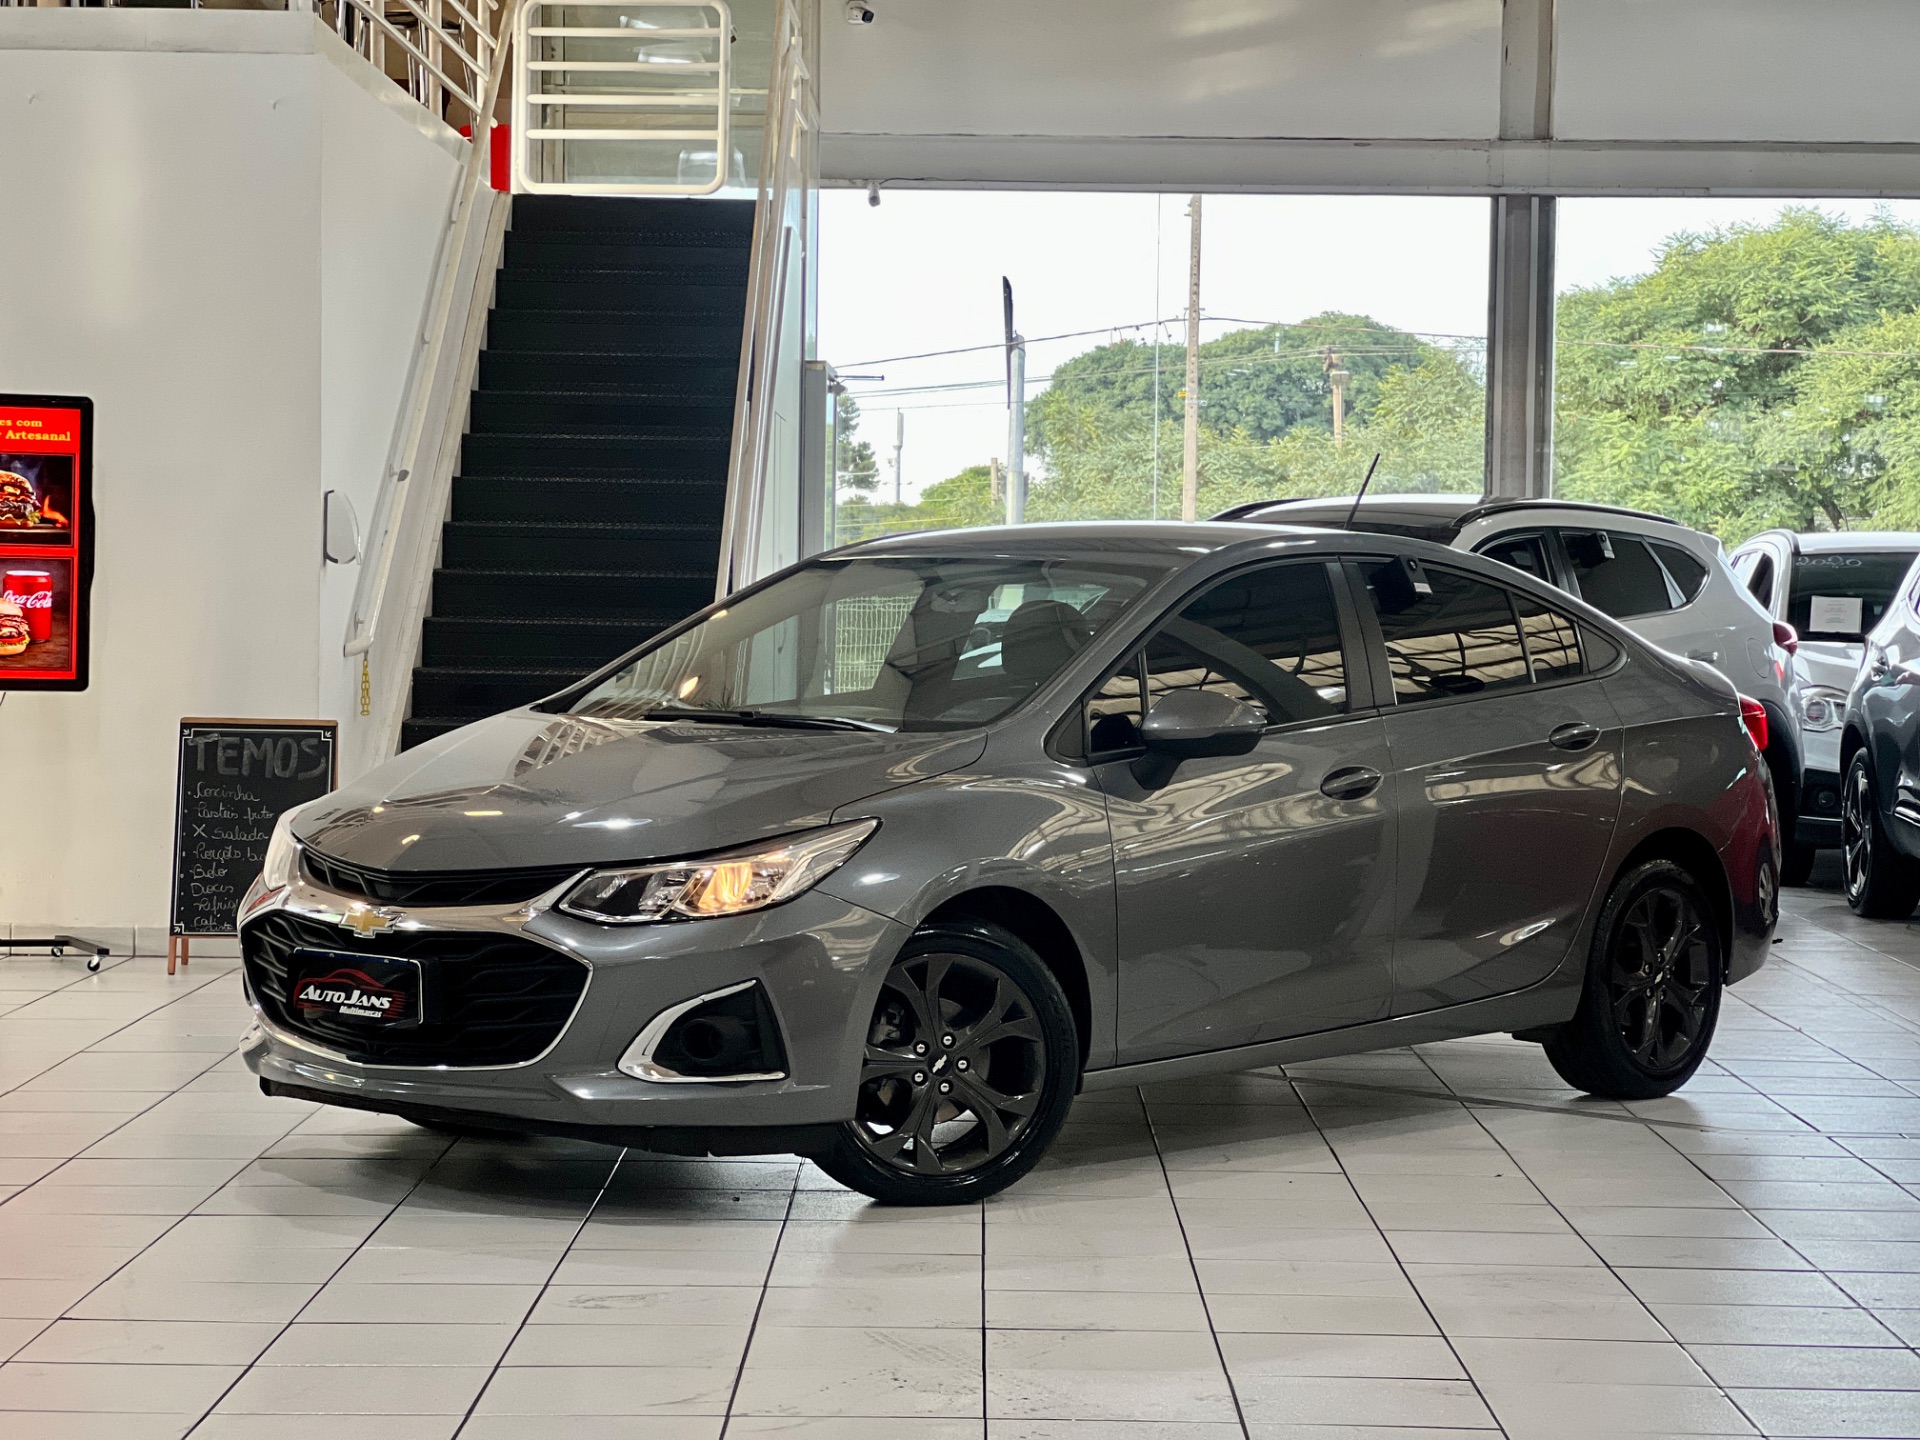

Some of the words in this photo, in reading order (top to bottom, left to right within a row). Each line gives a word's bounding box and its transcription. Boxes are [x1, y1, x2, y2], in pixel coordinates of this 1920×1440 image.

[5, 430, 71, 441] Artesanal
[187, 732, 326, 780] TEMOS
[193, 781, 260, 801] Coxinha
[192, 824, 208, 837] X
[211, 825, 269, 841] Salada
